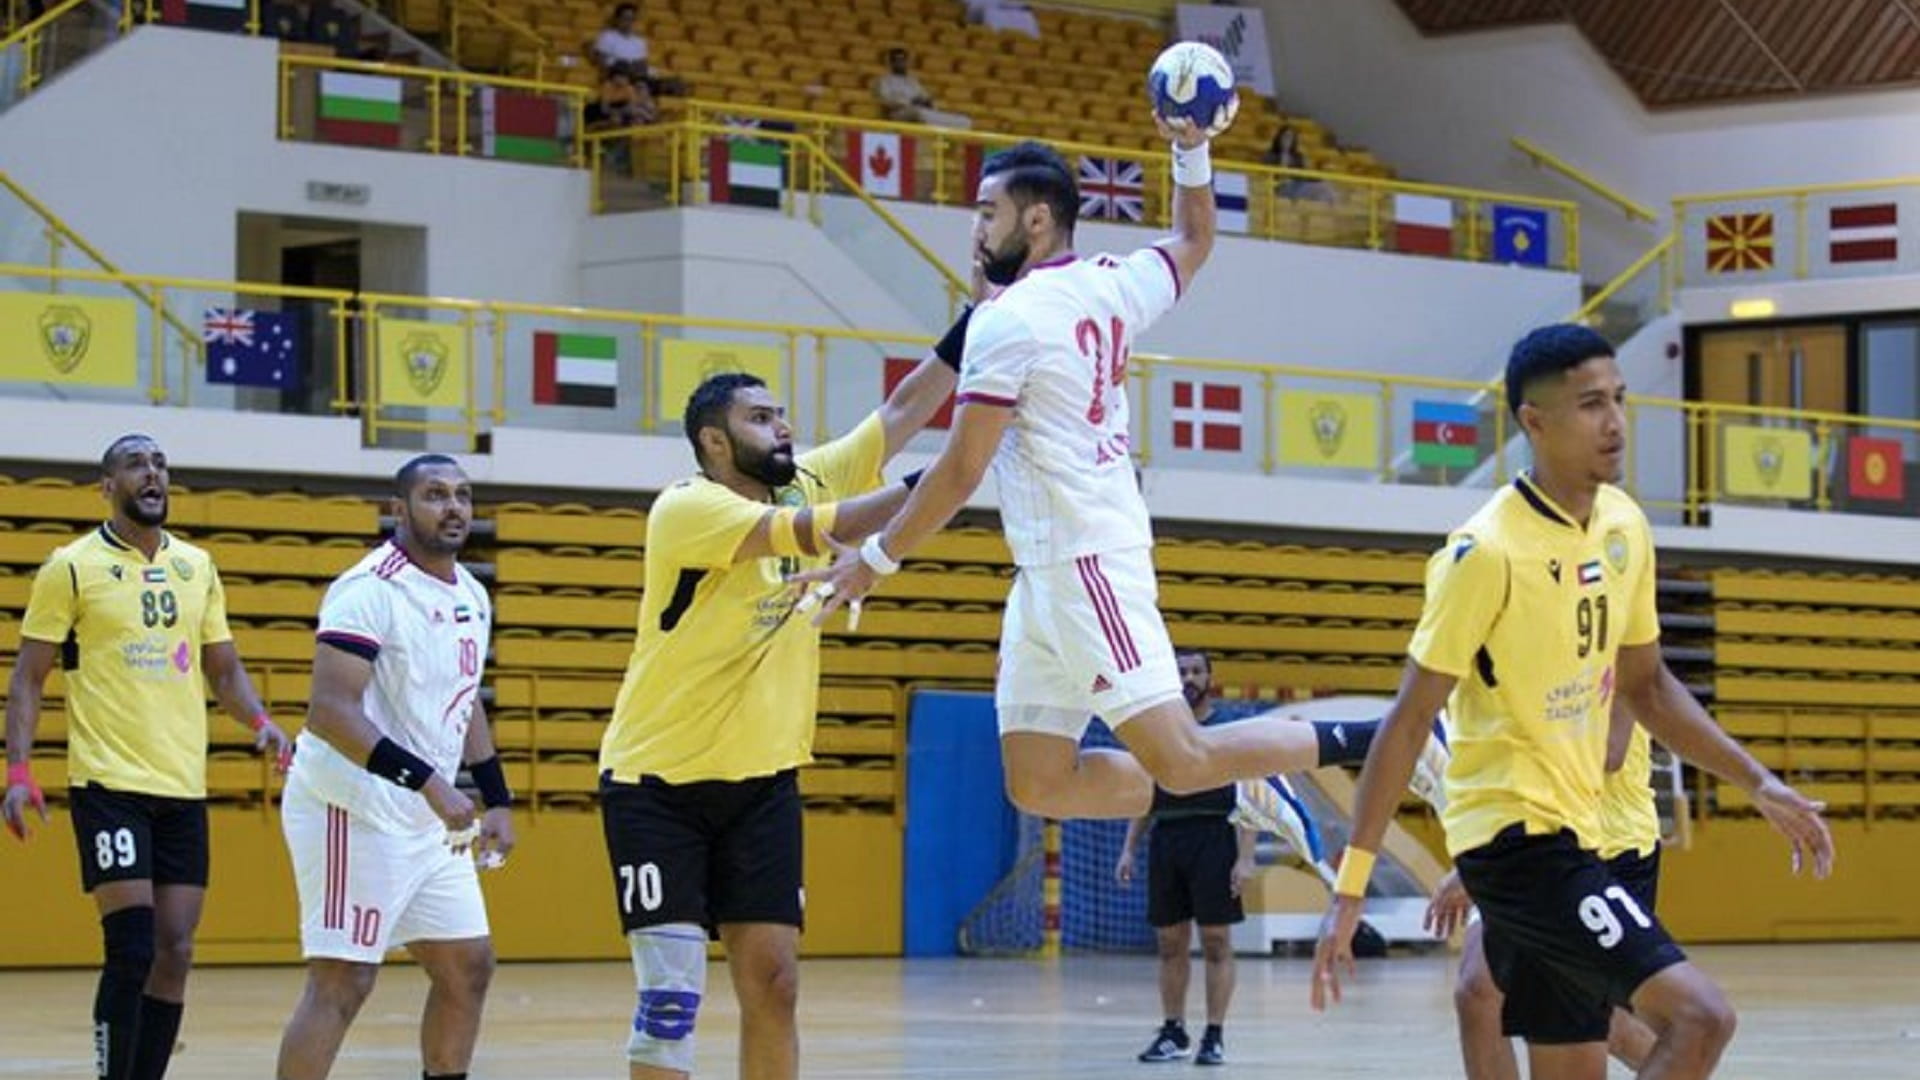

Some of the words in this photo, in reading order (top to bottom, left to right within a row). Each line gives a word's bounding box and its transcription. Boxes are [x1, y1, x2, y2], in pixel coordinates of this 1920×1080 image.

[141, 589, 178, 629] 89
[1576, 594, 1608, 659] 91
[459, 637, 478, 677] 10
[95, 827, 136, 870] 89
[620, 862, 662, 913] 70
[352, 904, 381, 948] 10
[1578, 885, 1652, 949] 91
